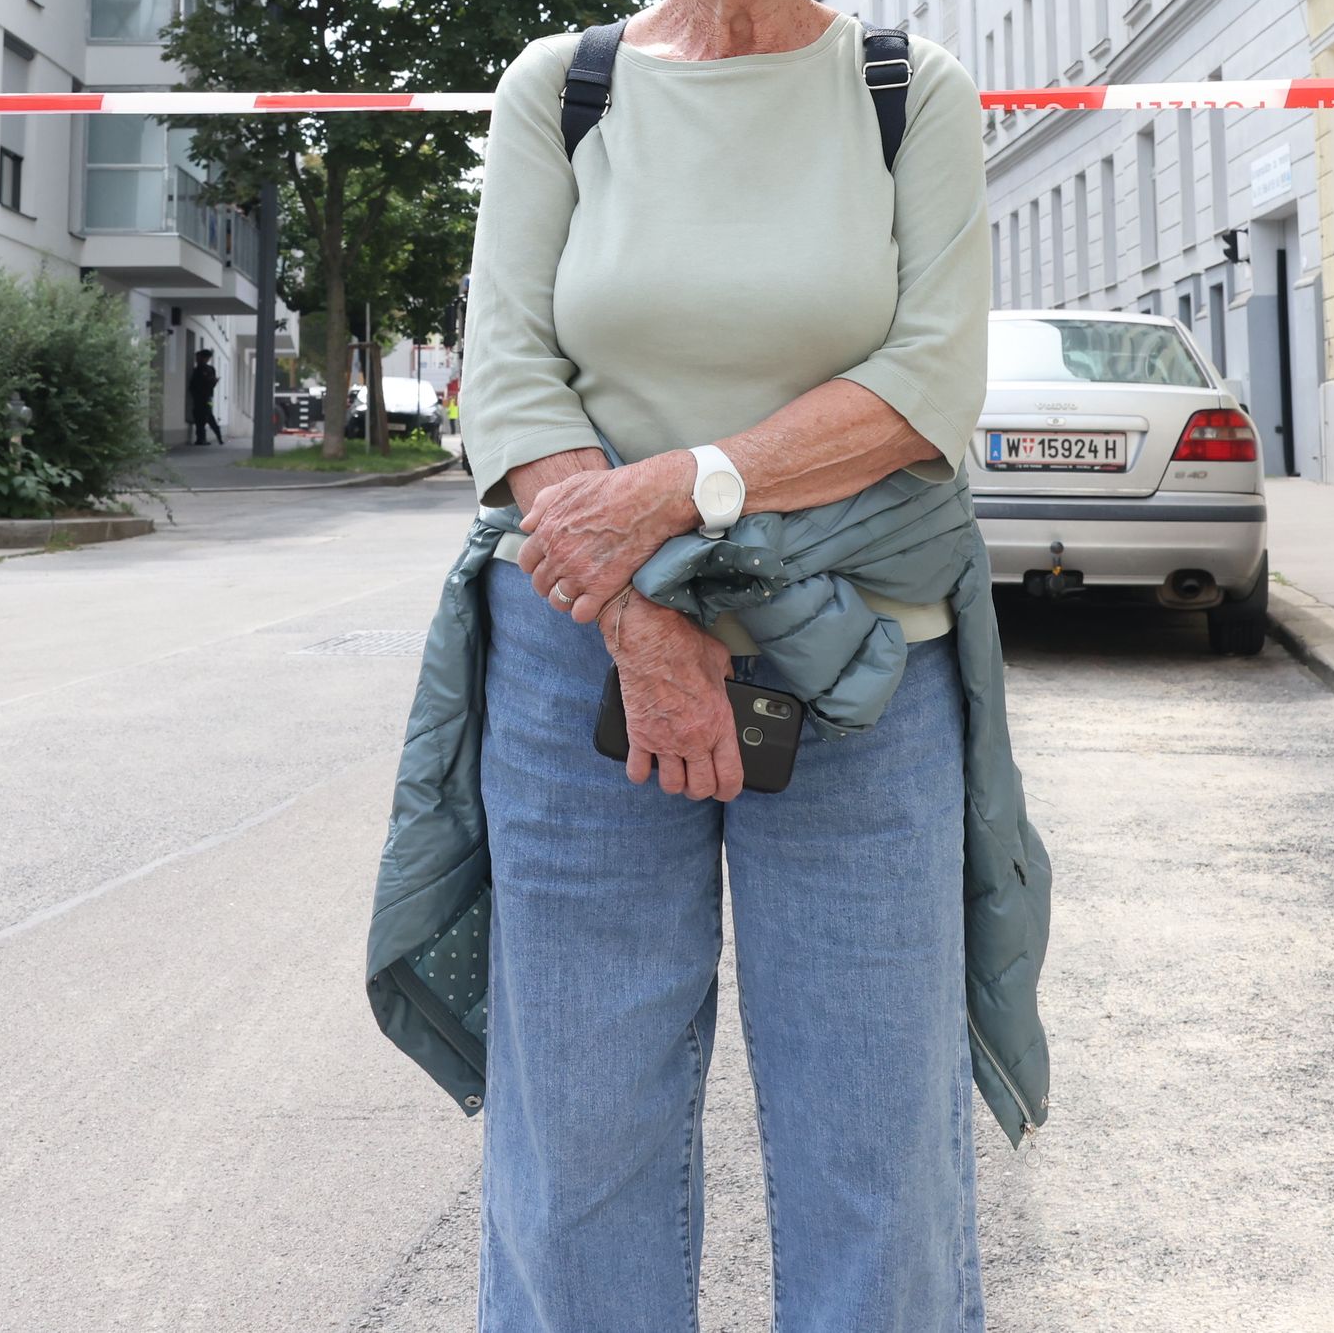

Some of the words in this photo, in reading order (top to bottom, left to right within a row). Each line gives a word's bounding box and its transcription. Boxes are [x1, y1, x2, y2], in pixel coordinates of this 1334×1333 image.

[1006, 437, 1021, 458] W
[1037, 438, 1099, 460] 15924
[1105, 439, 1116, 459] H
